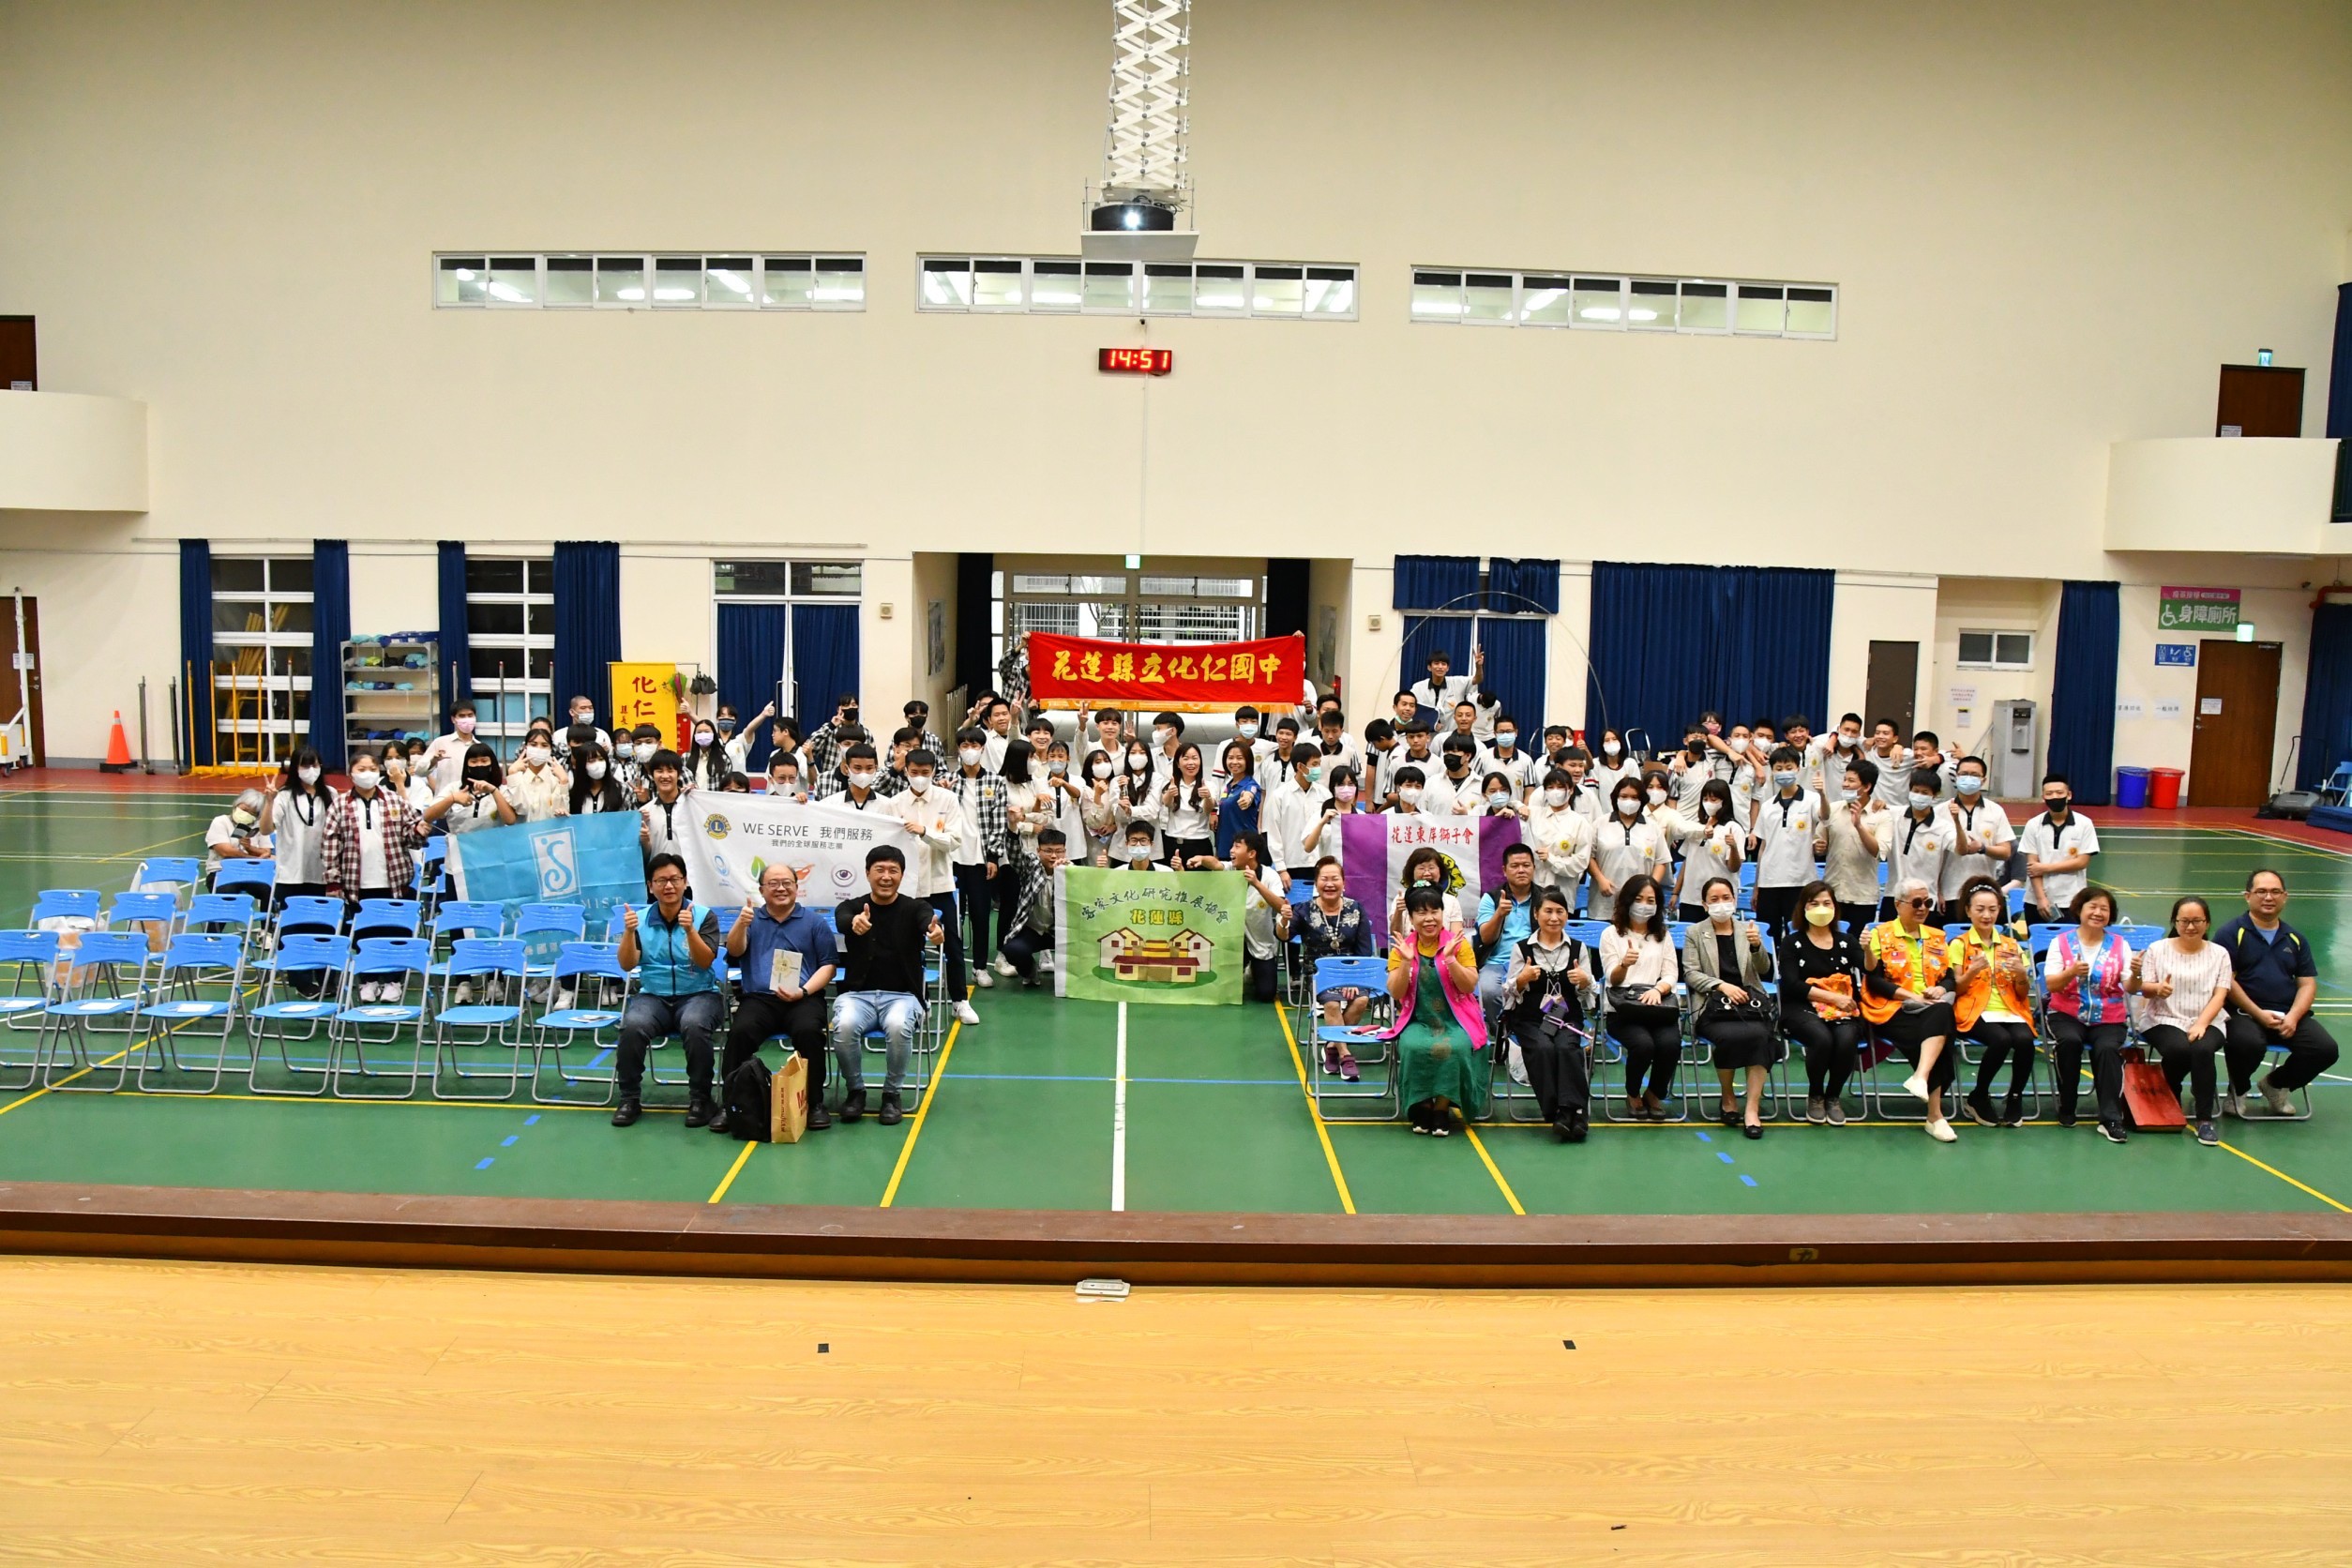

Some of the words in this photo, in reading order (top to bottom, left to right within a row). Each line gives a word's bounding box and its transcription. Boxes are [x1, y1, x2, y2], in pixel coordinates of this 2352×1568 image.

[1110, 350, 1168, 369] 14:51
[2179, 604, 2237, 625] 身障廁所
[1051, 650, 1282, 685] 花蓮縣立化仁國中
[632, 675, 656, 727] 化仁
[743, 822, 764, 835] WE
[767, 824, 809, 837] SERVE
[820, 826, 873, 841] 我們服務
[1391, 826, 1474, 845] 花蓮東岸獅子會
[1130, 909, 1184, 926] 花蓮縣
